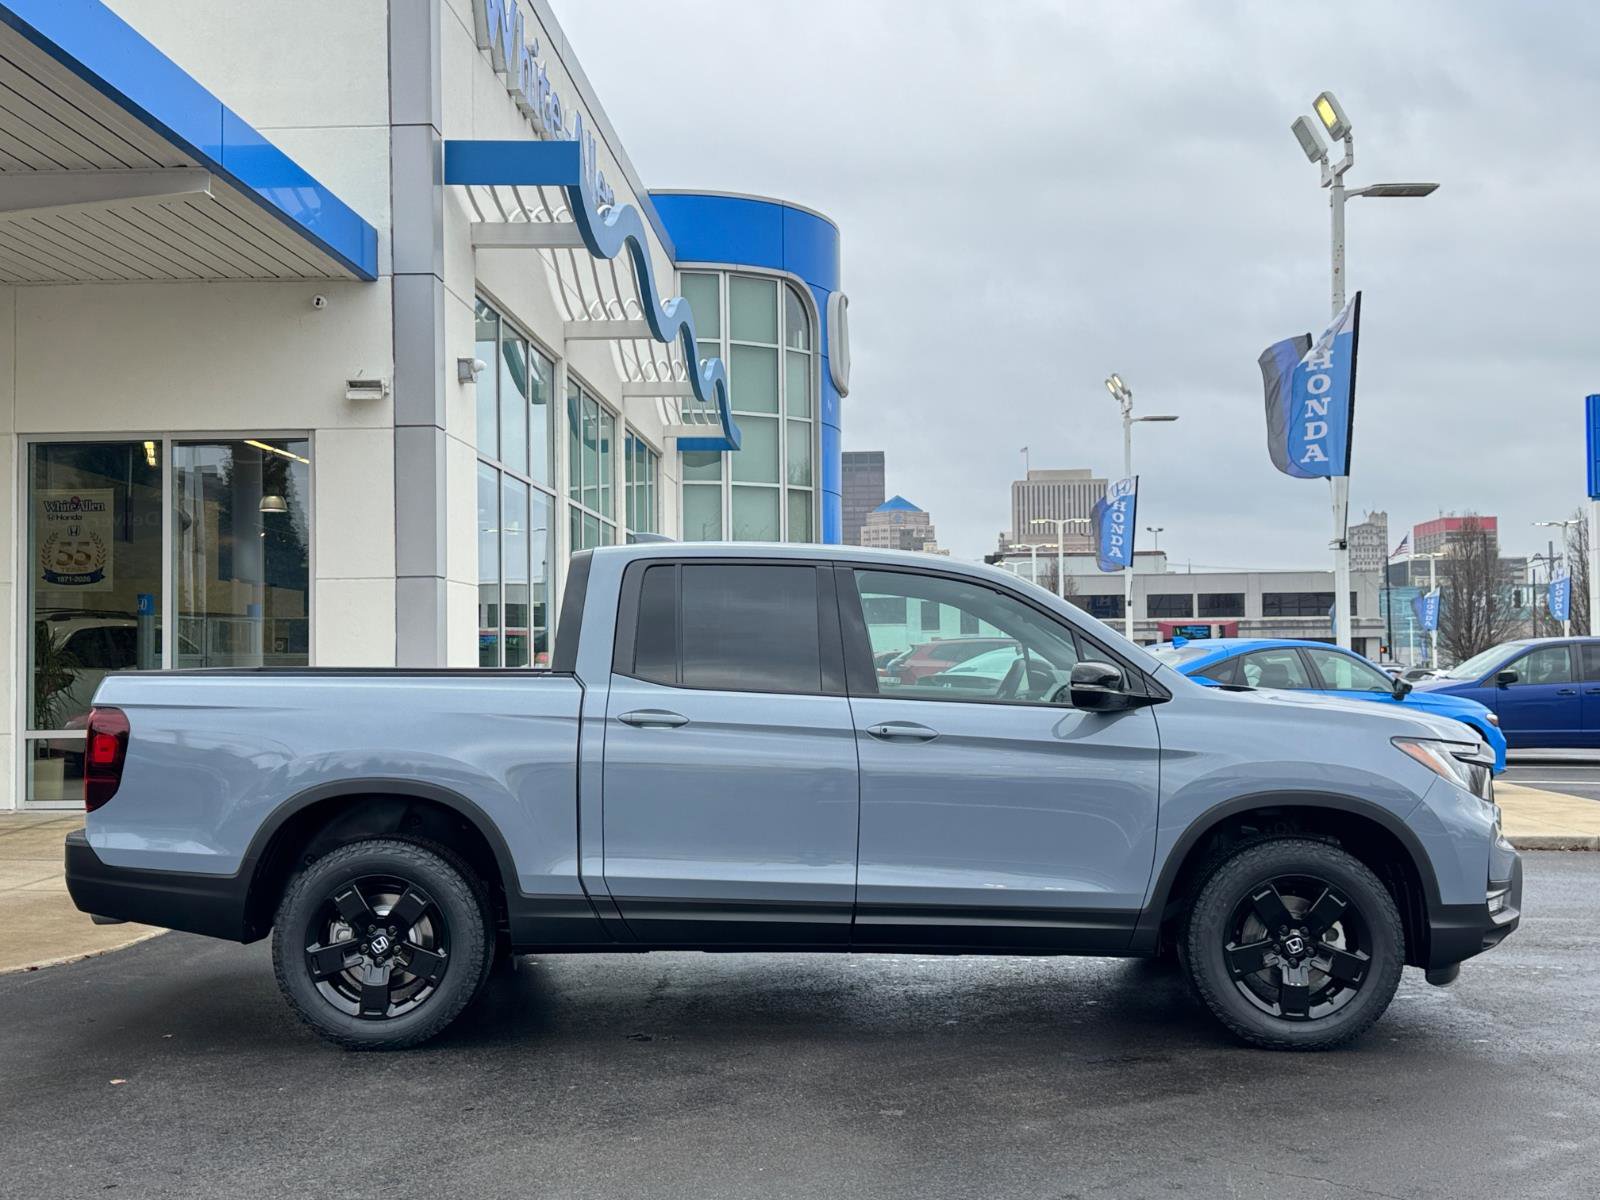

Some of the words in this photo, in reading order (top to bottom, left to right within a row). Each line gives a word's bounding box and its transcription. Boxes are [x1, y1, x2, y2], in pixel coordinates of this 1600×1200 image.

[1300, 349, 1334, 464] HONDA
[1108, 500, 1128, 558] HONDA
[56, 541, 92, 567] 55
[1554, 582, 1565, 617] HONDA
